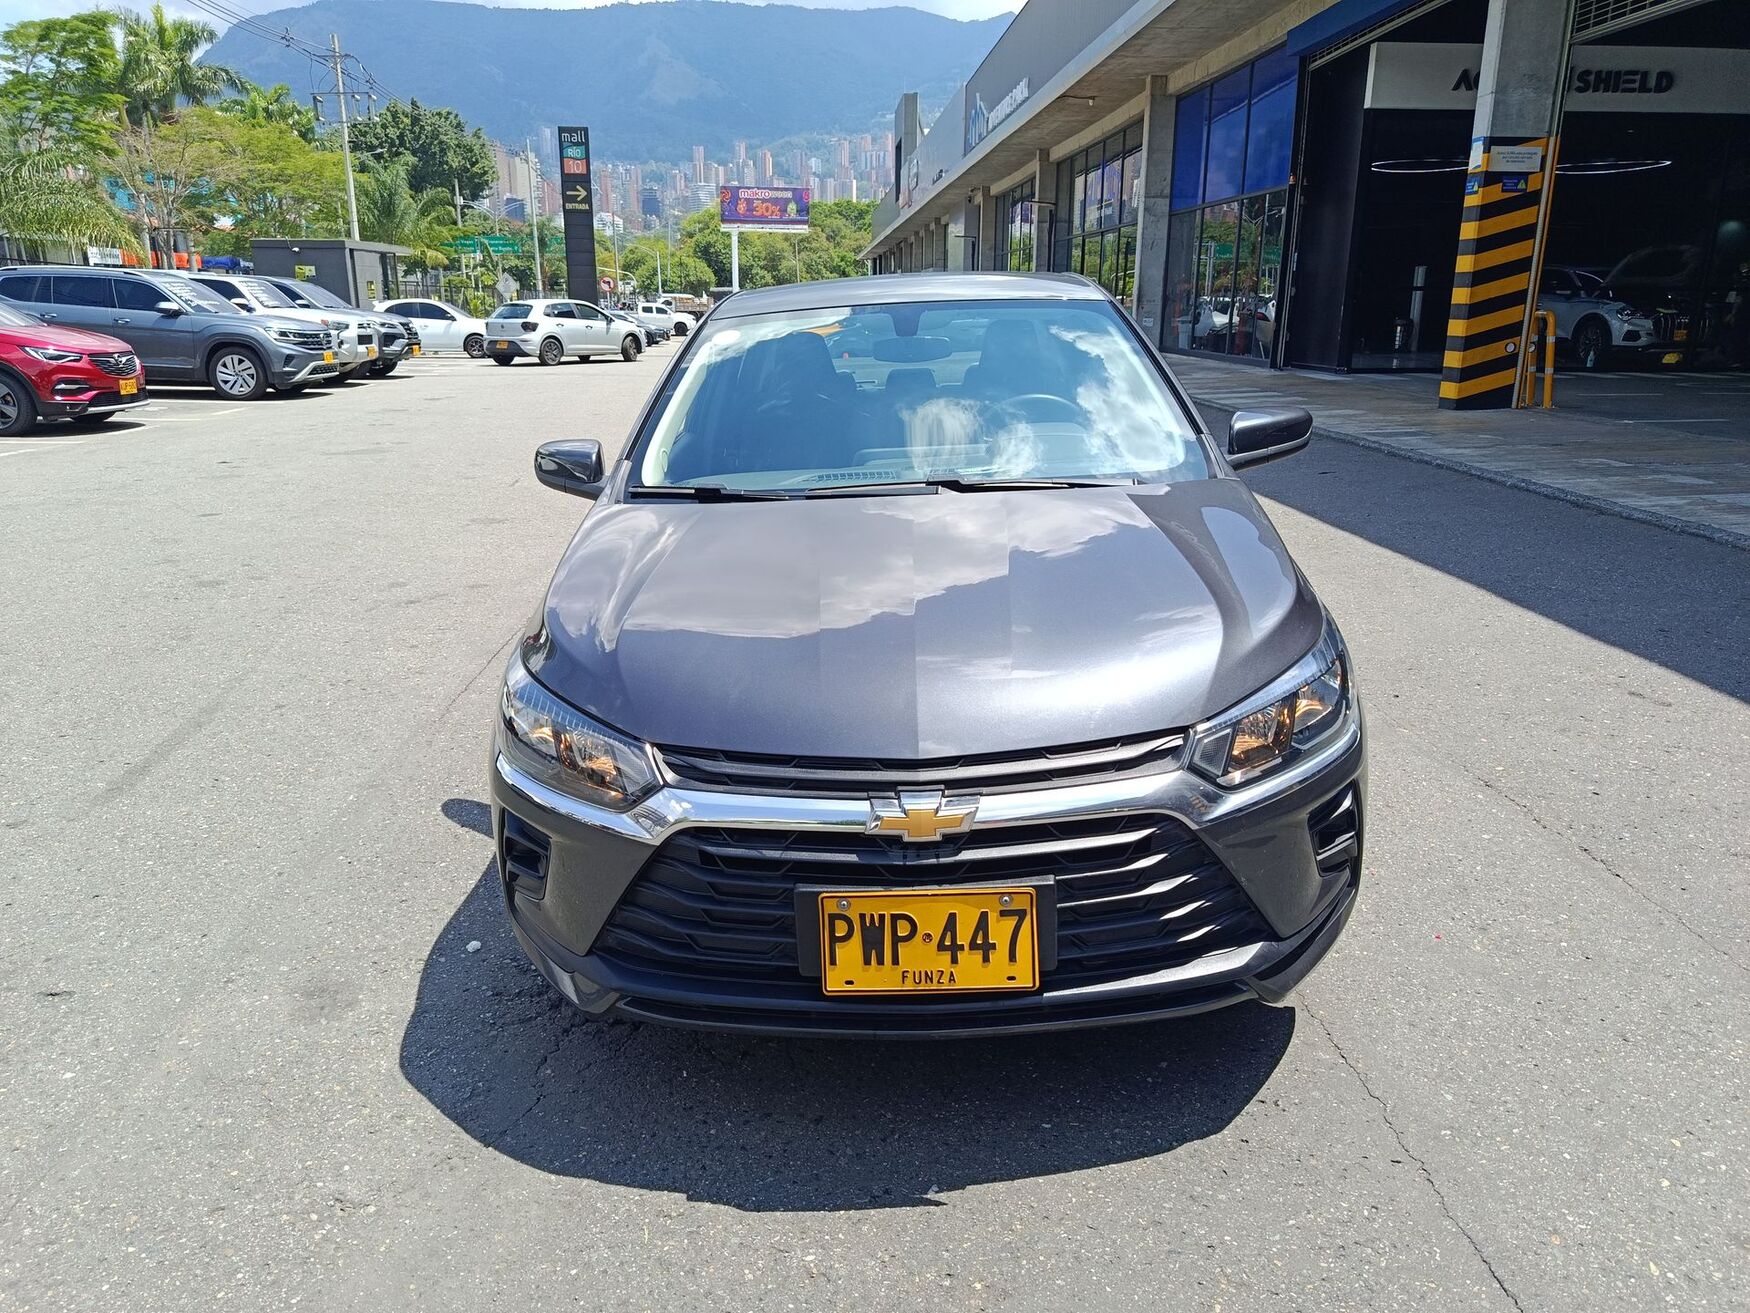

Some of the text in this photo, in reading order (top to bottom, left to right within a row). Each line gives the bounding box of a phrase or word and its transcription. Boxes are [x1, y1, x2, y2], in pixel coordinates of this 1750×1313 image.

[1575, 69, 1674, 94] SHIELD
[561, 130, 585, 142] mall
[568, 161, 582, 173] 10
[901, 969, 957, 985] FUNZA
